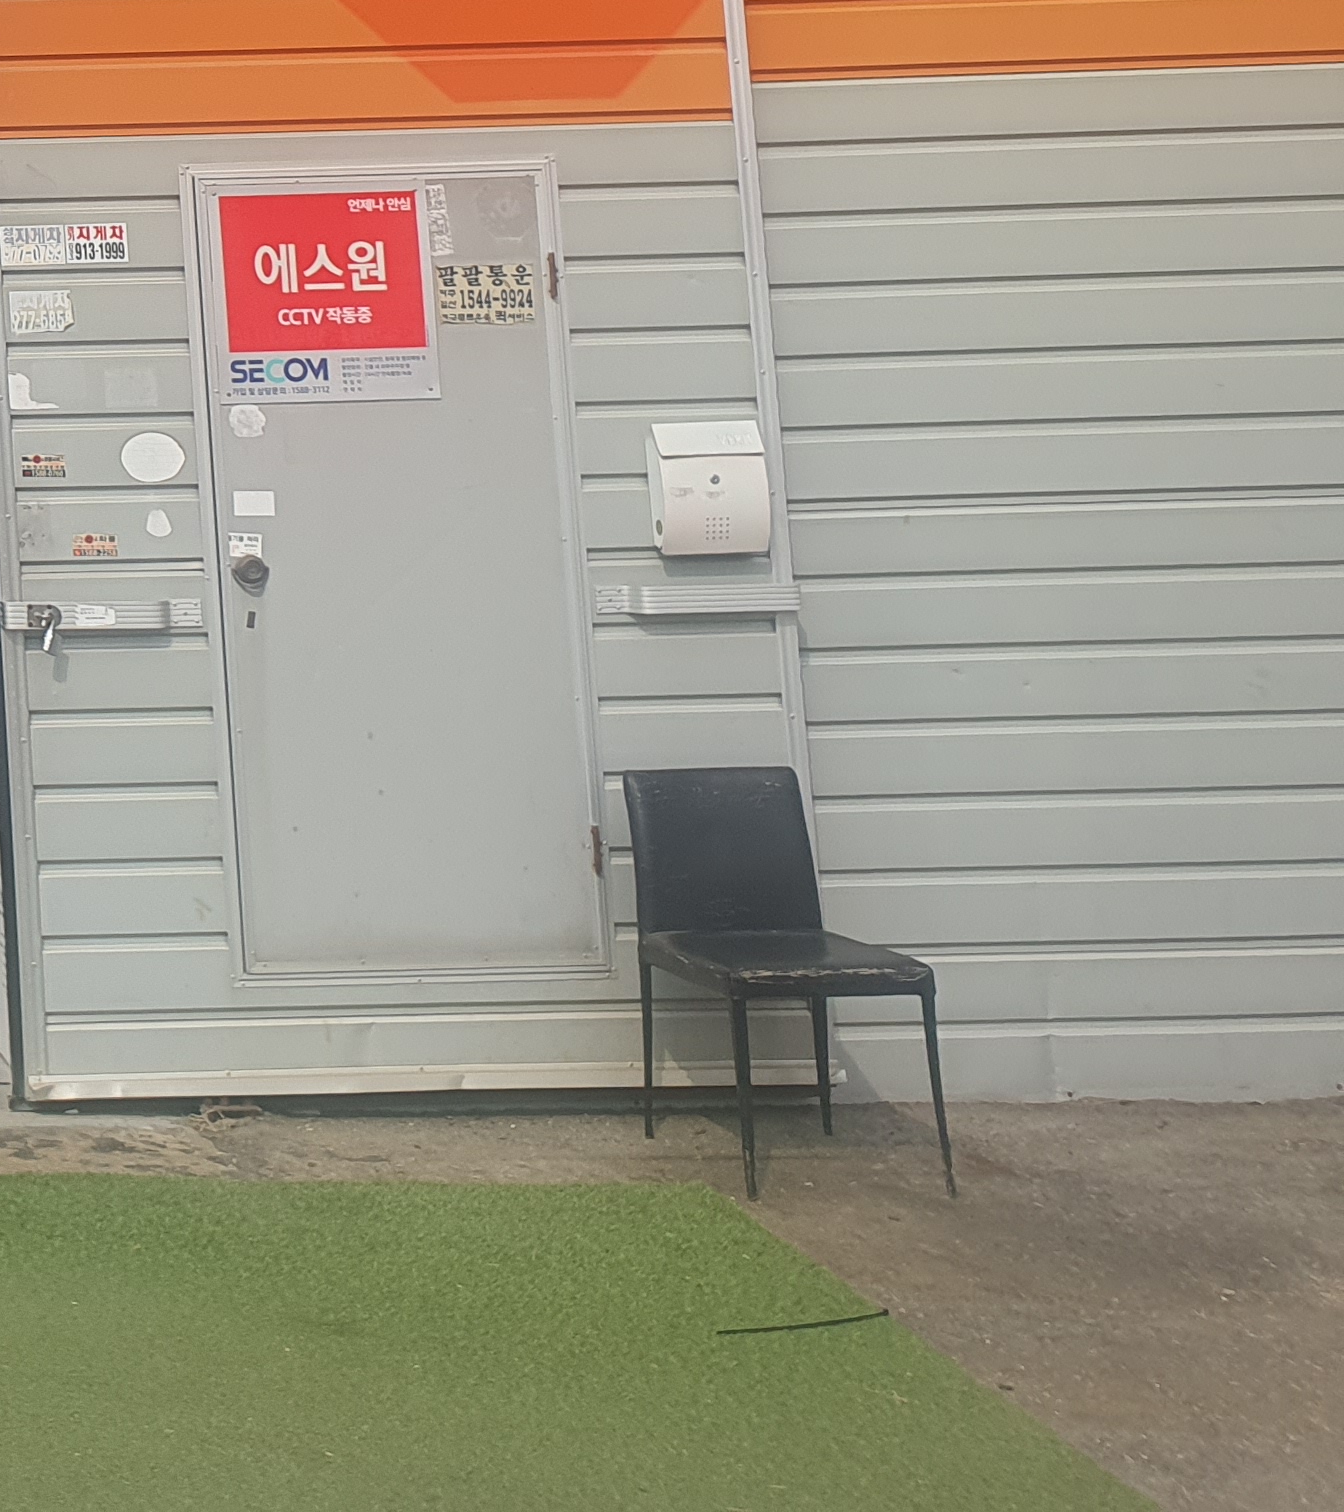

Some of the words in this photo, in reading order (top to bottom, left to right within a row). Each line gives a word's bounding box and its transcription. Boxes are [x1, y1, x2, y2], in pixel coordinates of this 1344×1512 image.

[347, 198, 385, 212] 언제나
[386, 197, 411, 211] 안심
[76, 225, 124, 241] 지게차
[75, 242, 125, 261] 913-1999
[254, 241, 388, 293] 에스원
[436, 264, 532, 287] 팔팔통운
[460, 289, 533, 308] 1544-9924
[278, 308, 324, 325] CCTV
[326, 306, 372, 324] 작동중
[230, 357, 329, 383] SECOM
